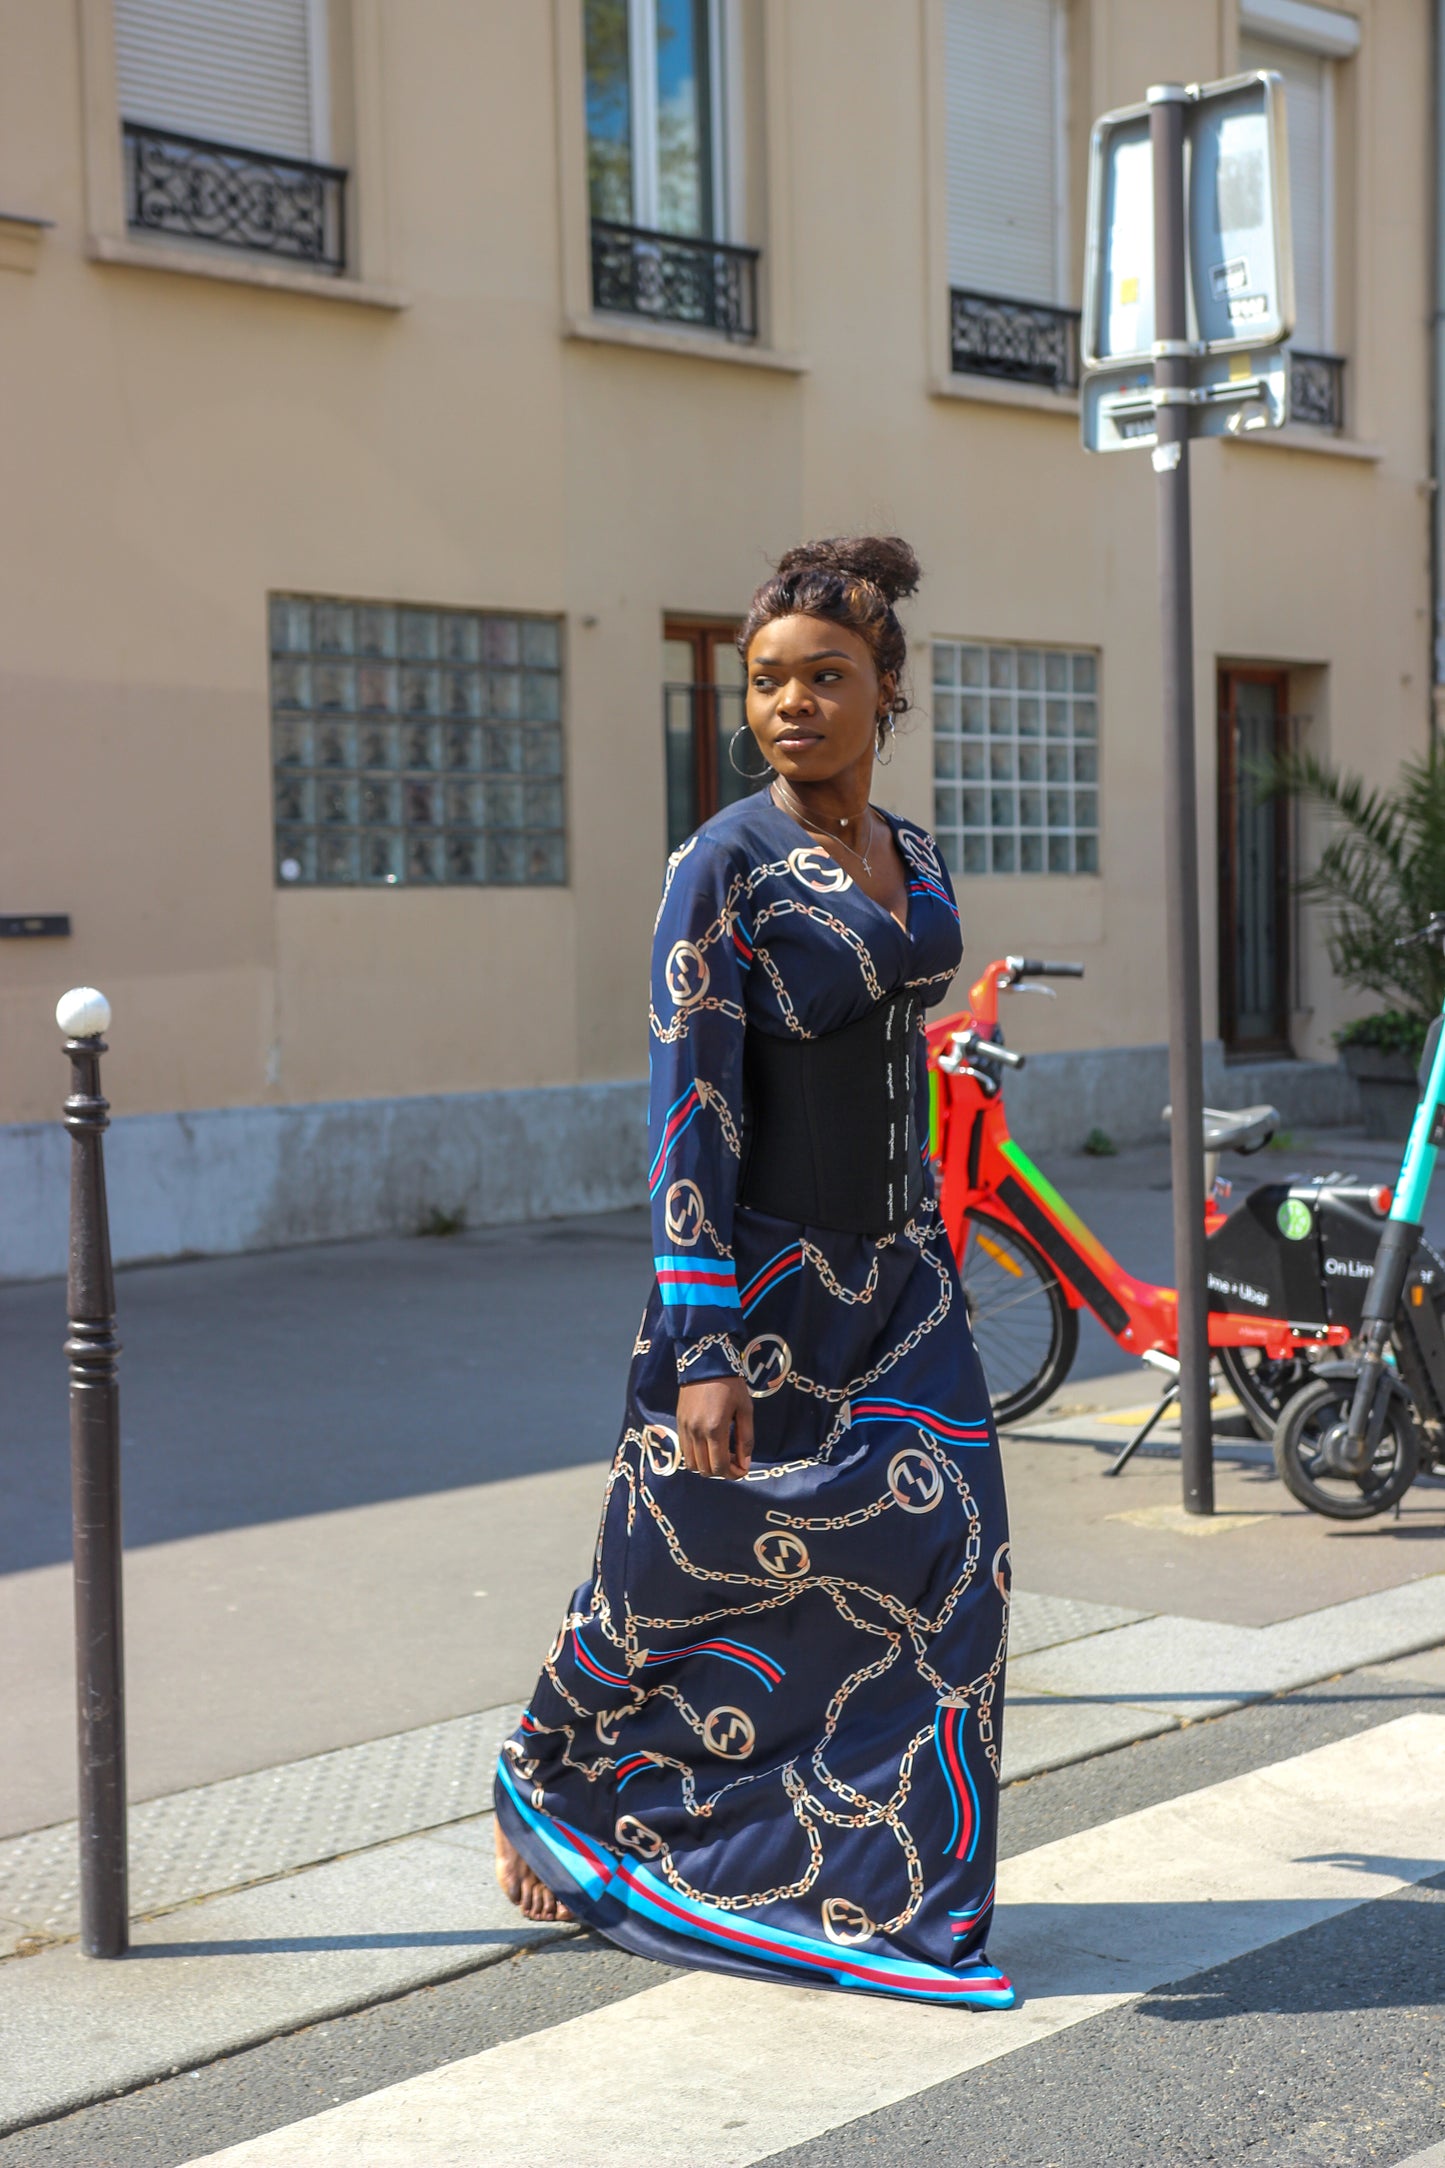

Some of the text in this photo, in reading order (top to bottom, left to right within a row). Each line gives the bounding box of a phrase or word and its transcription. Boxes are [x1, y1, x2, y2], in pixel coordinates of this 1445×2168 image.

[1325, 1258, 1375, 1278] On Lim
[1207, 1272, 1230, 1294] ime
[1239, 1282, 1269, 1307] Uber
